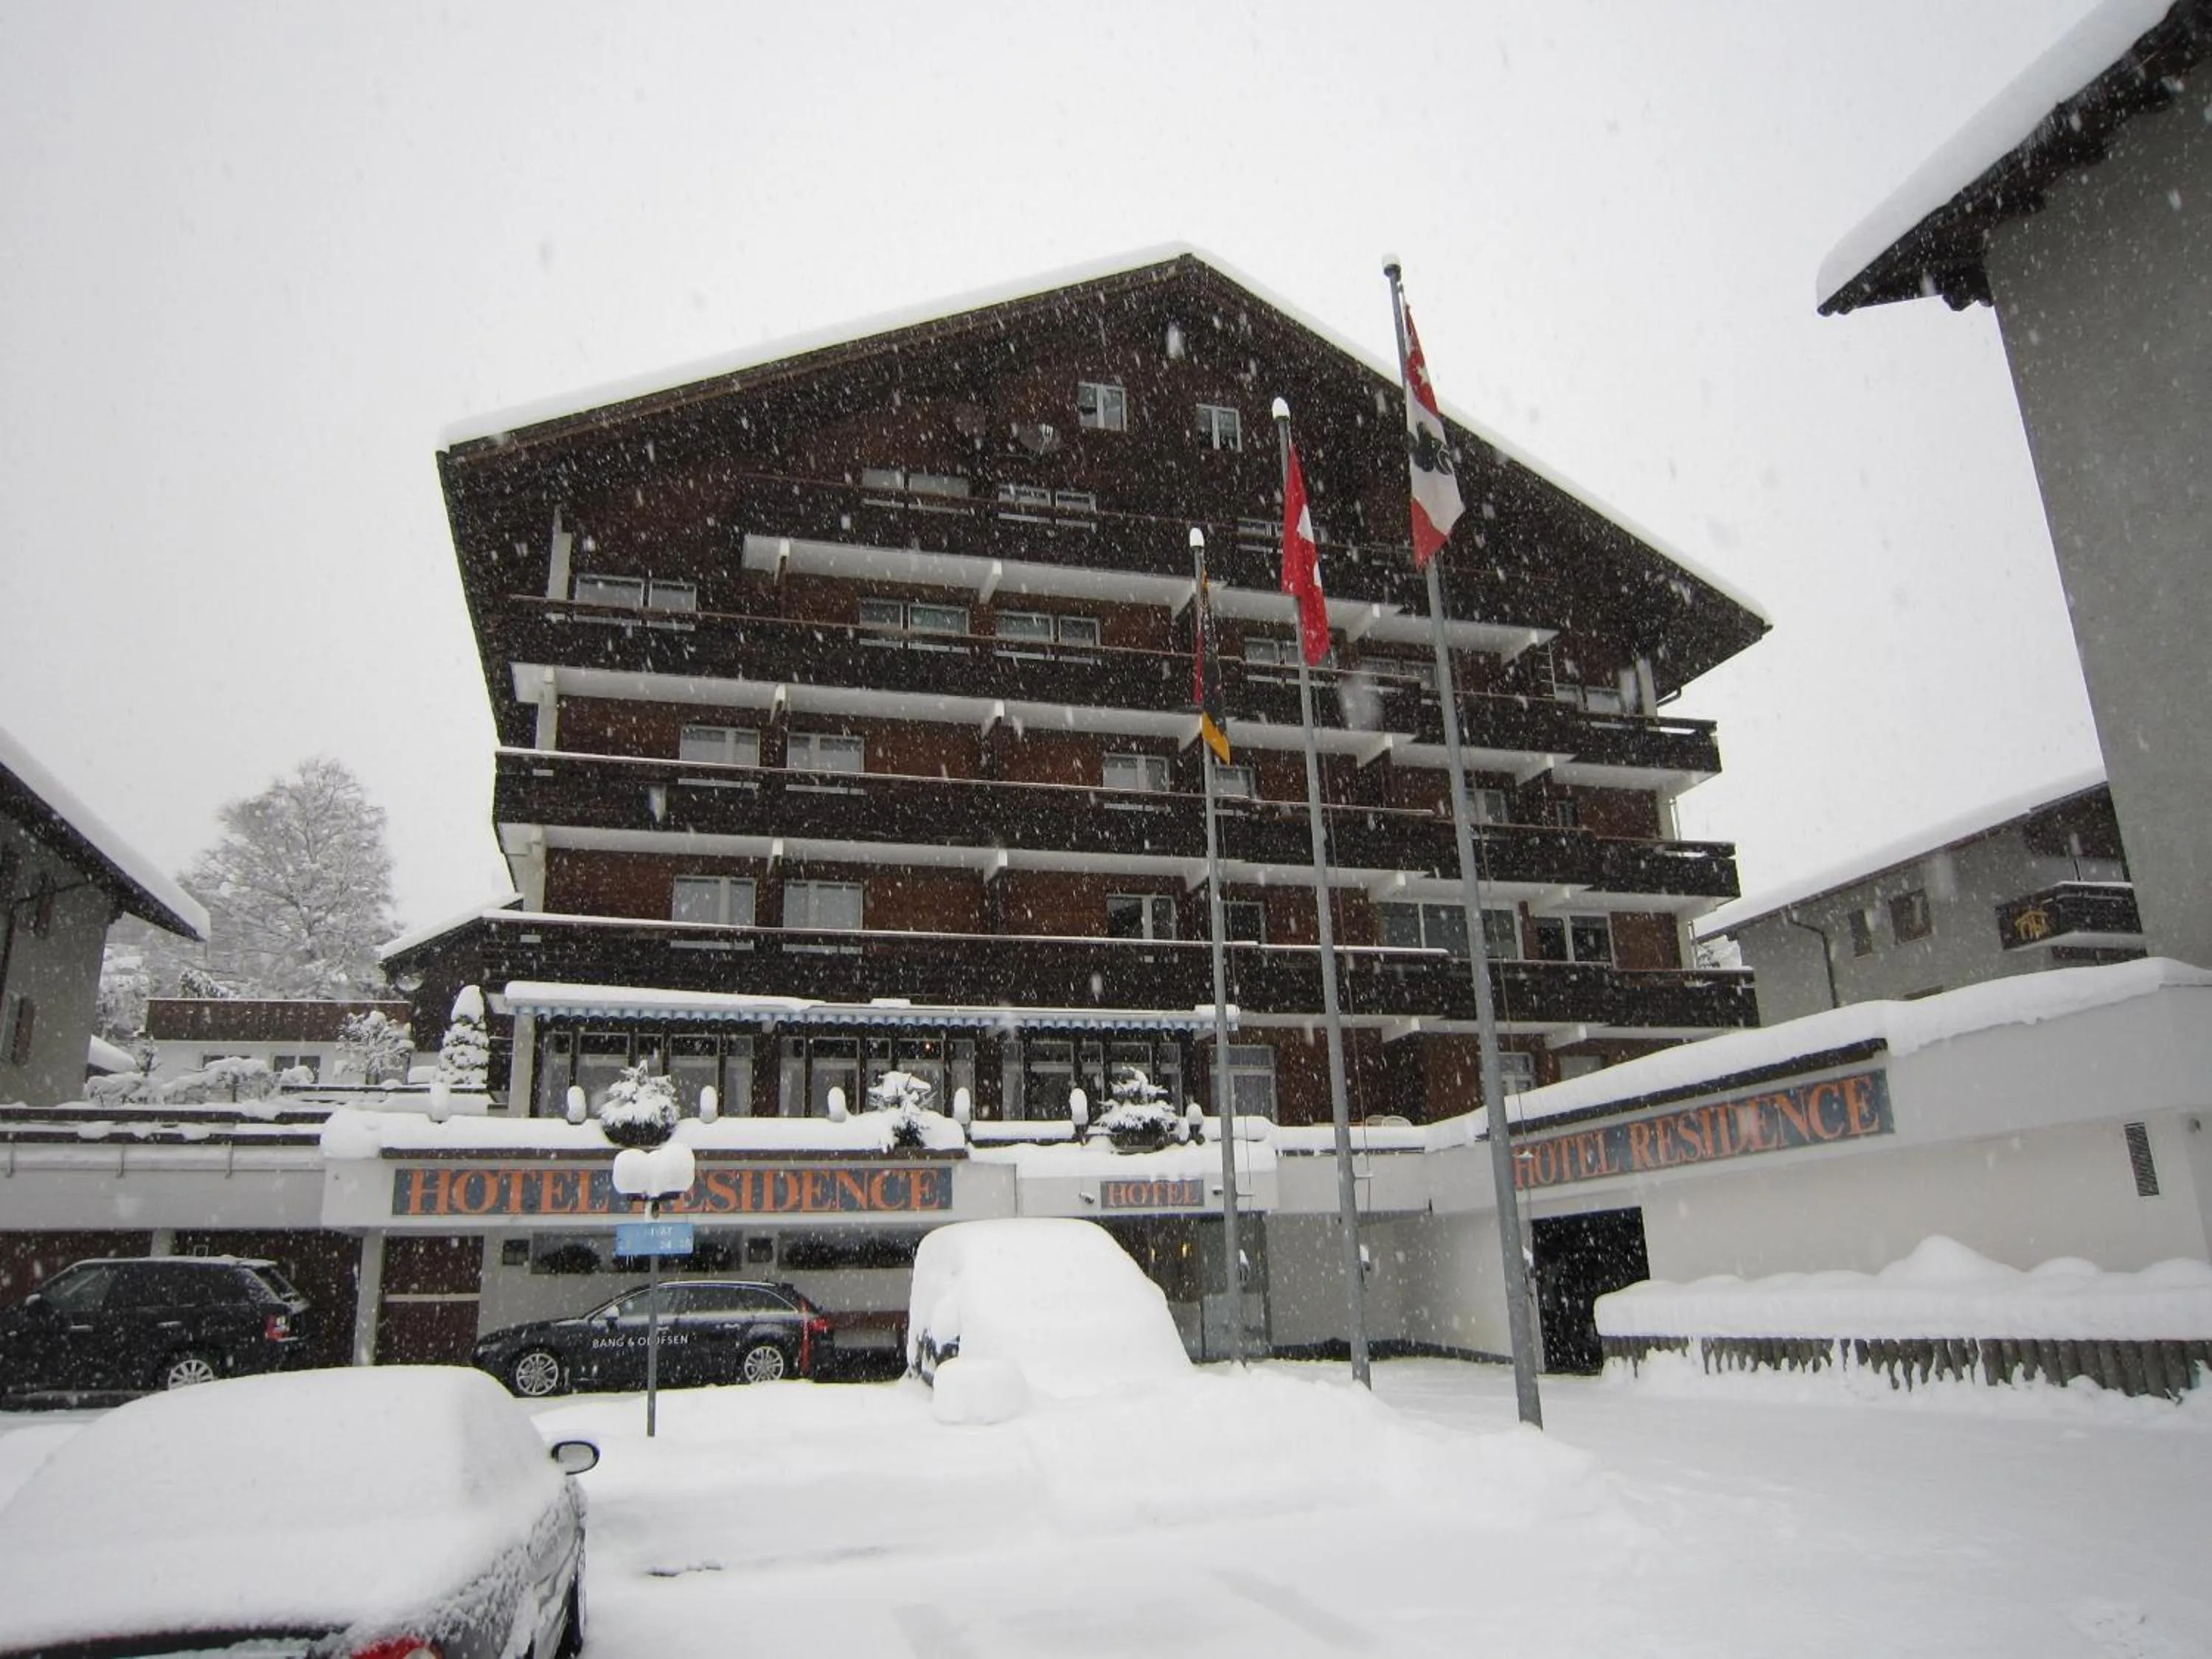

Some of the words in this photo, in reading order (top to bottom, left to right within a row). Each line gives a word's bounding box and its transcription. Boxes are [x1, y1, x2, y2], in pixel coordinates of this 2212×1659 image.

[1513, 1130, 1620, 1189] HOTEL
[1628, 1075, 1879, 1169] RESIDENCE
[408, 1169, 610, 1214] HOTEL
[627, 1167, 941, 1213] ESIDENCE
[1107, 1181, 1200, 1207] HOTEL
[592, 1338, 625, 1348] BANG
[627, 1337, 634, 1346] &
